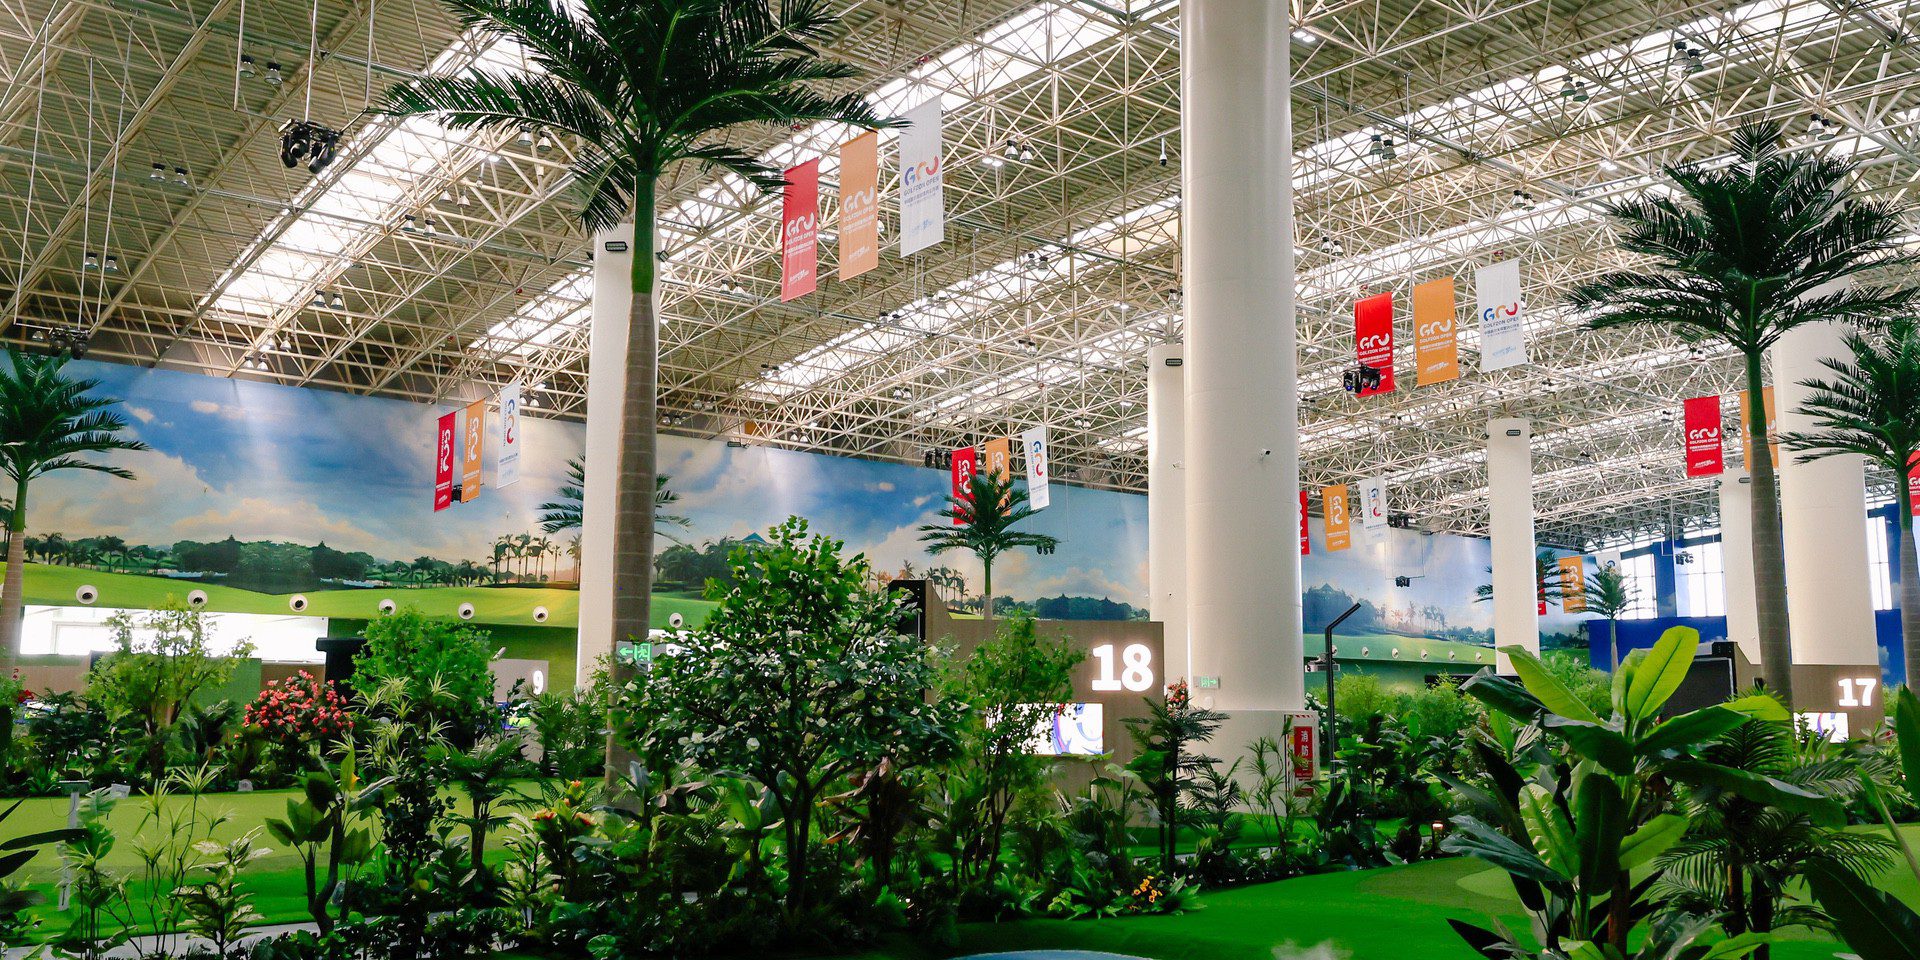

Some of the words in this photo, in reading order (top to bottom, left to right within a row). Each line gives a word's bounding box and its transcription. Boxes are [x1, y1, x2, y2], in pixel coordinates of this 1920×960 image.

[1091, 643, 1154, 692] 18
[532, 669, 544, 696] 9
[1837, 678, 1877, 707] 17
